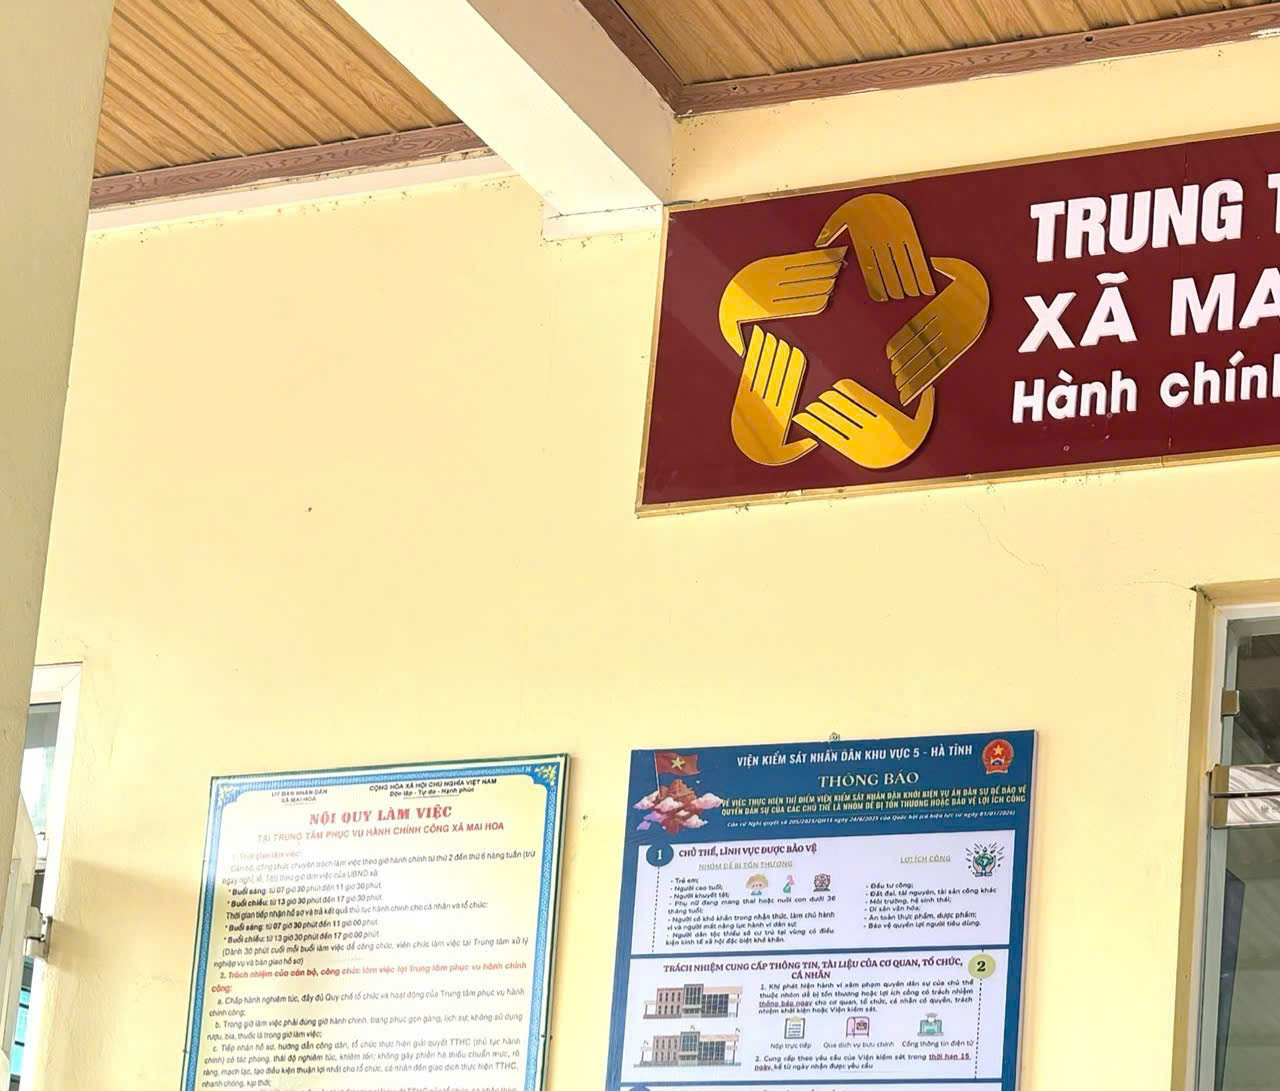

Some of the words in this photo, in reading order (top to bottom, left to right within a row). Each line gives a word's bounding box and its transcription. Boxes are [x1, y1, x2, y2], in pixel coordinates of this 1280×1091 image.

[1030, 178, 1243, 262] TRUNG
[1017, 272, 1138, 353] XÃ
[1012, 369, 1136, 423] Hành
[737, 756, 758, 768] VIỆN
[761, 752, 786, 765] KIỂM
[789, 751, 807, 763] SÁT
[810, 750, 837, 762] NHÂN
[840, 749, 861, 761] DÂN
[864, 749, 886, 759] KHU
[889, 748, 910, 760] VỰC
[913, 747, 919, 757] 5
[930, 745, 945, 756] HÀ
[948, 744, 972, 755] TĨNH
[817, 772, 878, 787] THÔNG
[884, 770, 918, 784] BÁO
[309, 811, 336, 825] NỘI
[340, 810, 372, 823] QUY
[377, 807, 410, 820] LÀM
[415, 804, 452, 819] VIỆC
[656, 849, 662, 860] 1
[678, 846, 696, 857] CHỦ
[698, 846, 718, 856] THỂ,
[719, 846, 740, 855] LĨNH
[742, 846, 759, 856] VỰC
[760, 845, 785, 855] ĐƯỢC
[786, 843, 804, 853] BẢO
[805, 842, 817, 854] VỆ
[663, 963, 692, 972] TRÁCH
[693, 962, 723, 972] NHIỆM
[750, 961, 768, 970] CẤP
[768, 961, 801, 971] THÔNG
[802, 961, 820, 971] TIN,
[822, 959, 836, 970] TÀI
[838, 959, 858, 969] LIỆU
[860, 959, 878, 967] CỦA
[892, 959, 920, 967] QUAN,
[921, 957, 934, 966] TỔ
[935, 957, 962, 966] CHỨC,
[976, 960, 986, 972] 2
[791, 970, 803, 979] CÁ
[804, 970, 830, 978] NHÂN
